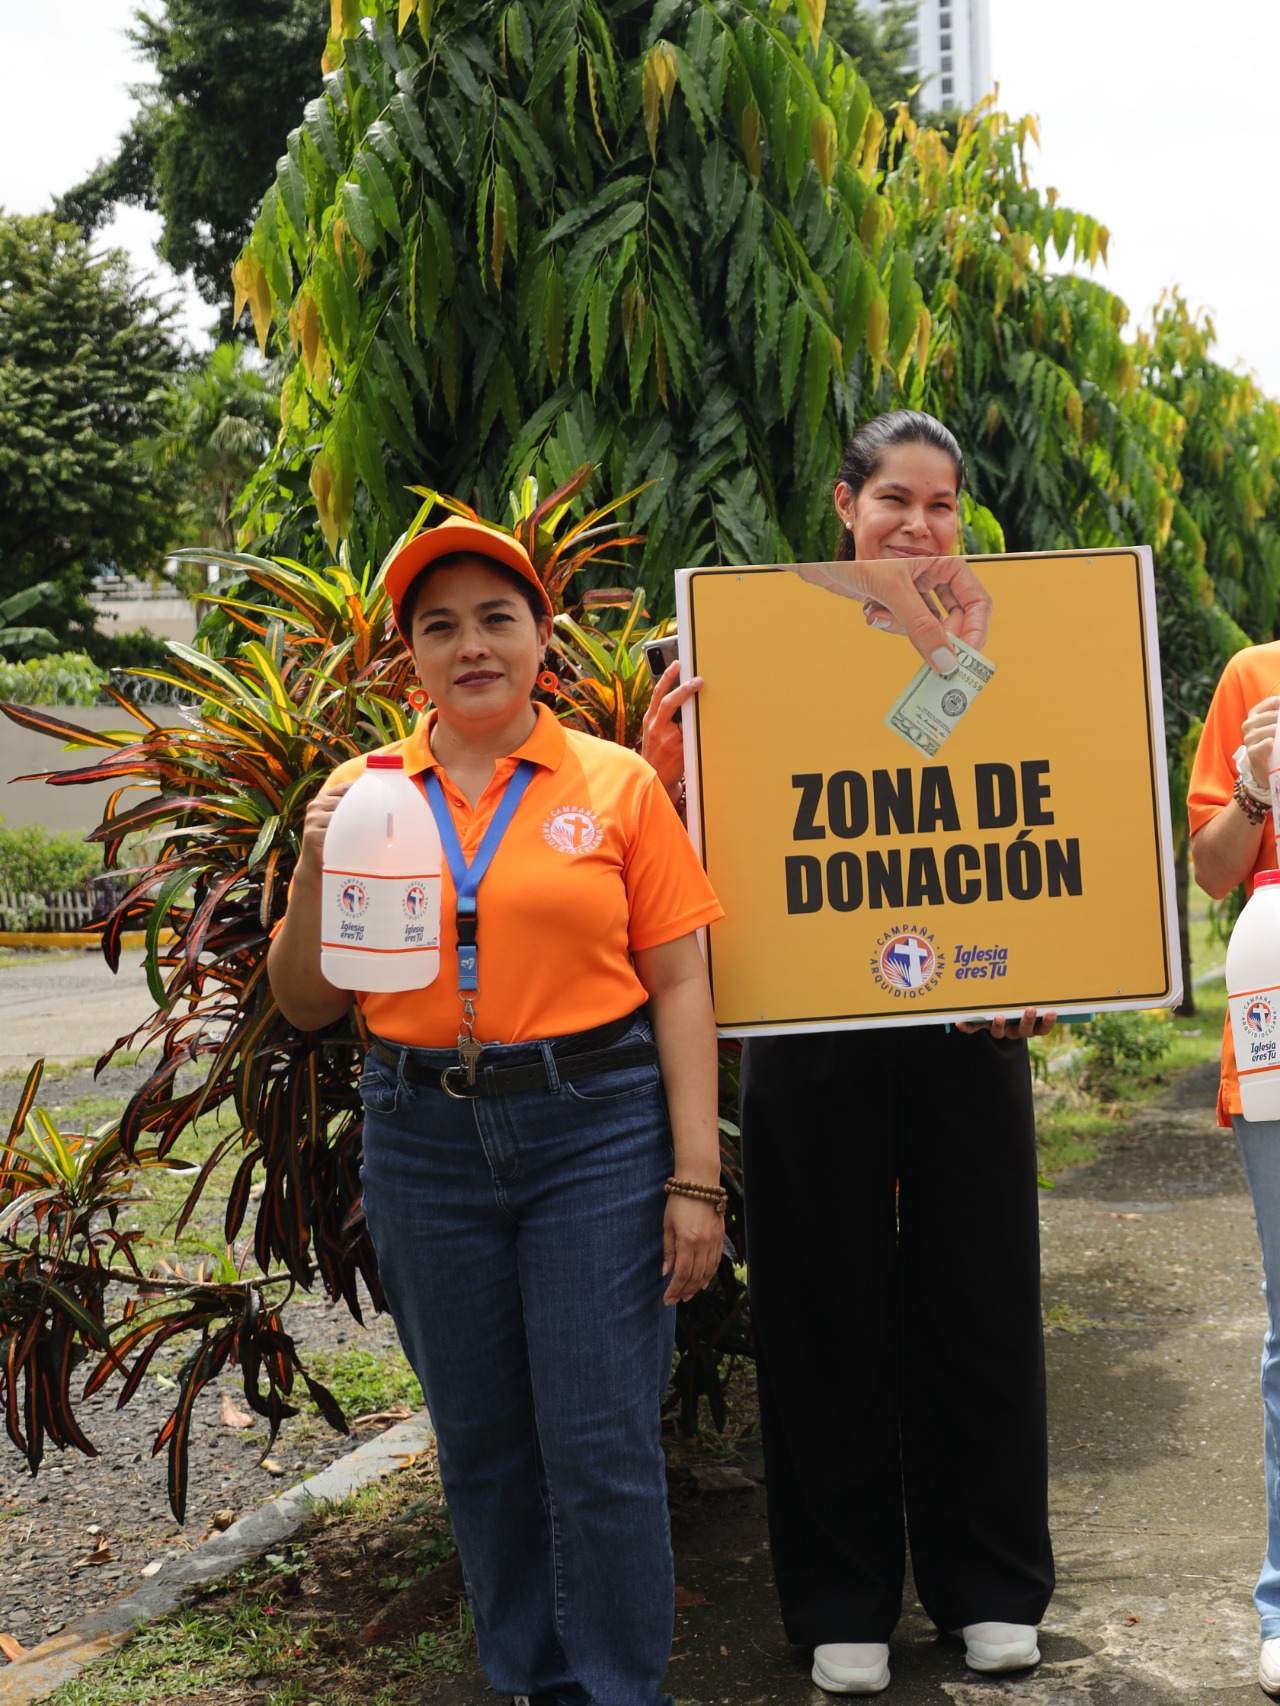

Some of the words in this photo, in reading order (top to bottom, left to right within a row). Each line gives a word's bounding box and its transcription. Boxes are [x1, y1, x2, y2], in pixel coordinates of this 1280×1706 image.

[792, 766, 961, 841] ZONA
[974, 759, 1055, 831] DE
[543, 822, 603, 854] ARQUIDIOCESANA
[785, 829, 1083, 915] DONACIÓN
[340, 920, 365, 932] Iglesia
[405, 924, 424, 935] Iglesia
[877, 924, 935, 946] CAMPAÑA
[954, 945, 1008, 967] Iglesia
[870, 953, 945, 998] ARQUIDIOCESANA
[1251, 1041, 1276, 1054] Iglesia
